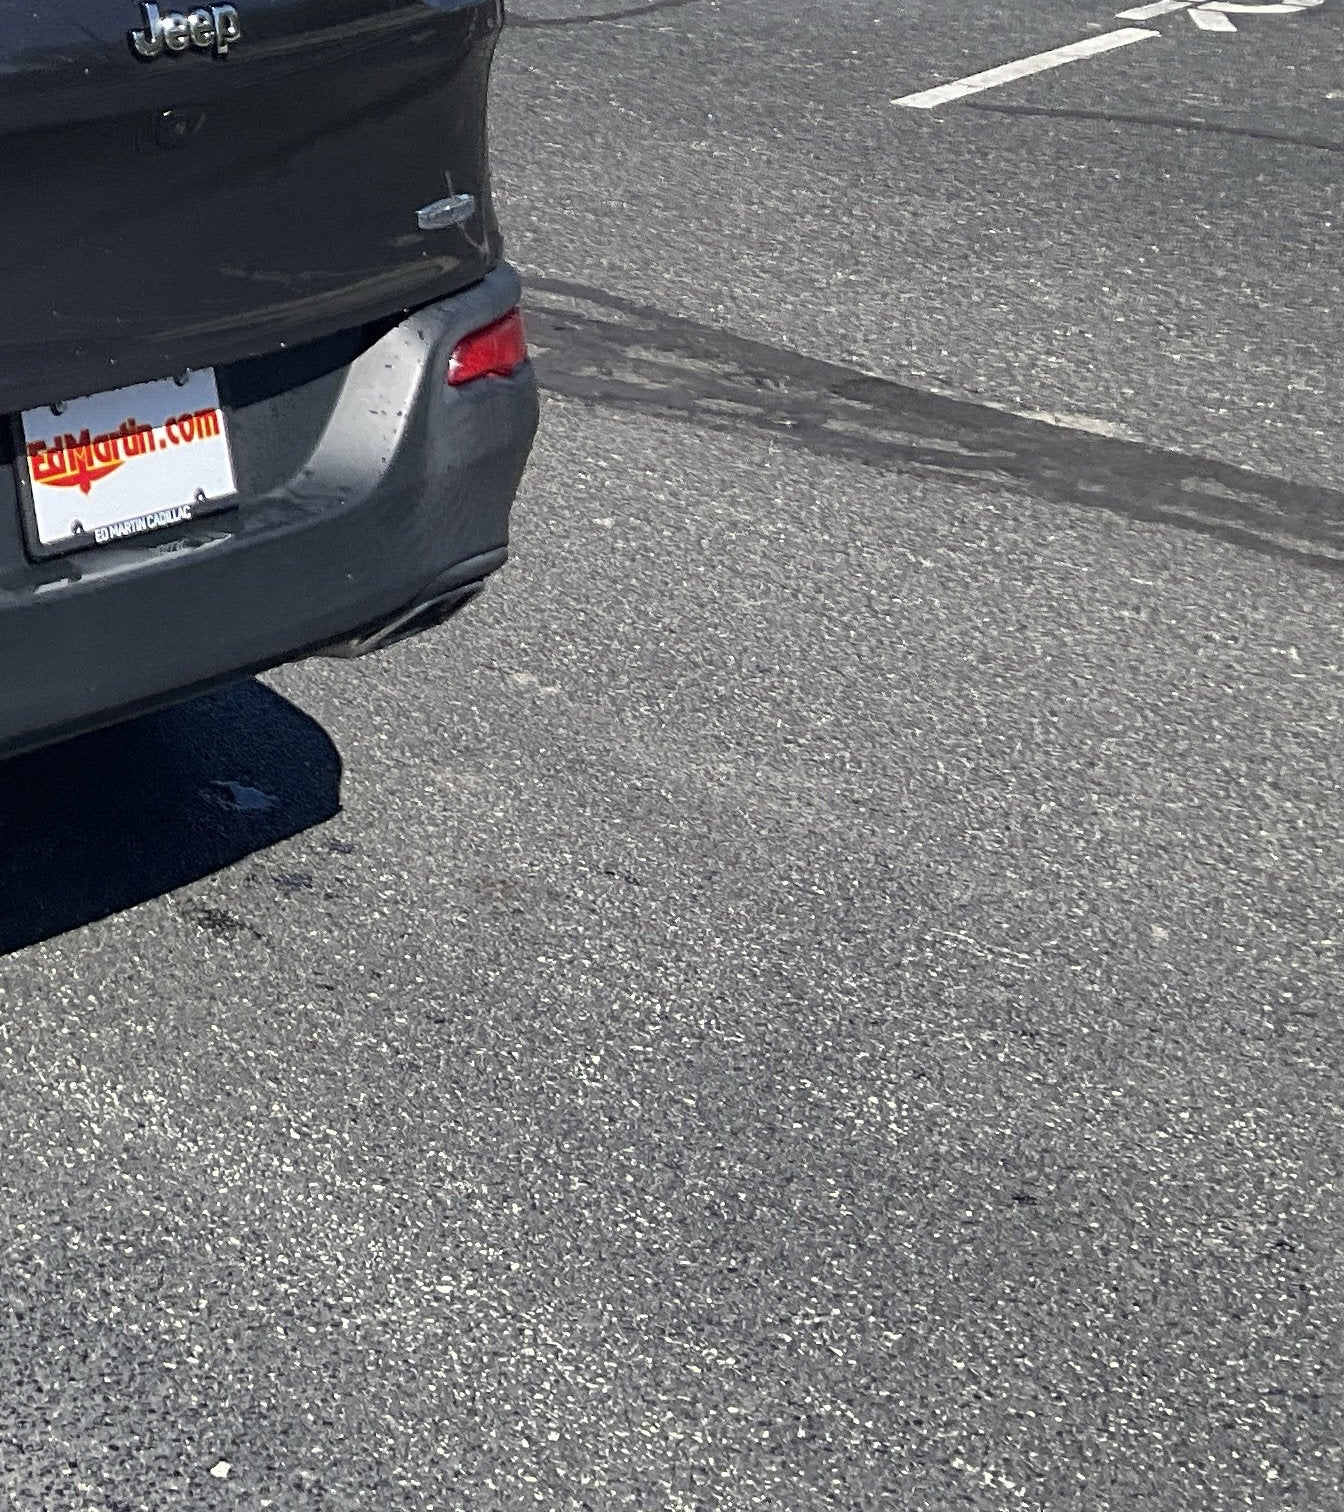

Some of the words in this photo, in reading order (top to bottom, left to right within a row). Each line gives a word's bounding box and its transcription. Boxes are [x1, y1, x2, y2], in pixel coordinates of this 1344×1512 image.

[130, 0, 241, 57] Jeep
[26, 408, 220, 482] EdMartin.com
[95, 527, 110, 543] ED
[110, 518, 147, 539] MARTIN
[146, 505, 193, 527] CADILLAC
